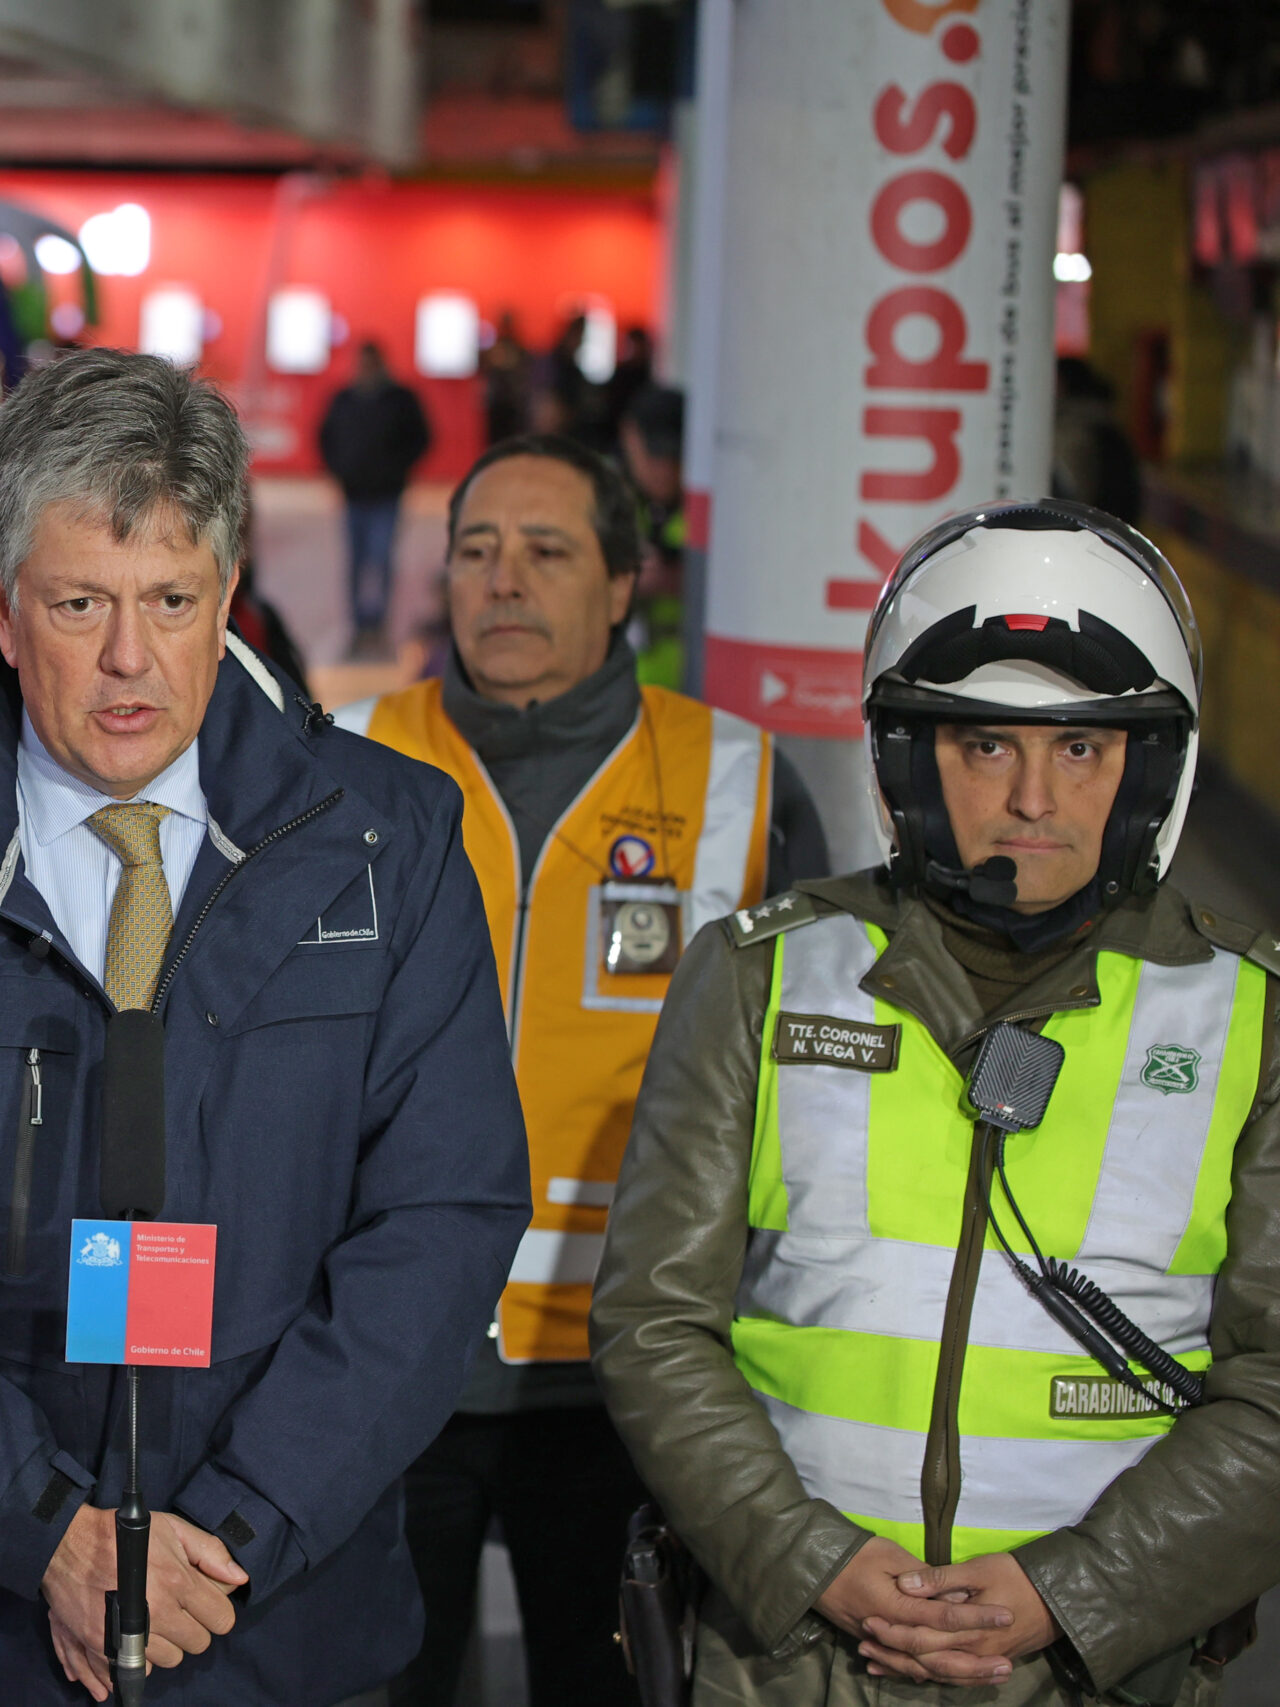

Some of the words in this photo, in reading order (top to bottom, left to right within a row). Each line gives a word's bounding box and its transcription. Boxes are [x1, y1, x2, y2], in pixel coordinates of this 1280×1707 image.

[1005, 104, 1030, 195] mejor
[1002, 201, 1023, 229] al
[1000, 241, 1021, 297] bus
[999, 308, 1019, 345] de
[997, 355, 1019, 476] pasajes
[321, 930, 349, 939] Gobierno
[349, 929, 358, 937] de
[359, 928, 374, 936] Chile
[788, 1023, 816, 1038] TTE.
[819, 1025, 886, 1048] CORONEL
[792, 1040, 808, 1054] N.
[813, 1041, 856, 1061] VEGA
[861, 1048, 876, 1063] V.
[136, 1234, 175, 1243] Ministerio
[176, 1235, 186, 1243] de
[136, 1244, 178, 1253] Transportes
[179, 1247, 185, 1255] y
[136, 1254, 210, 1265] Telecomunicaciones
[130, 1345, 169, 1355] Gobierno
[171, 1347, 182, 1355] de
[183, 1347, 205, 1357] Chile
